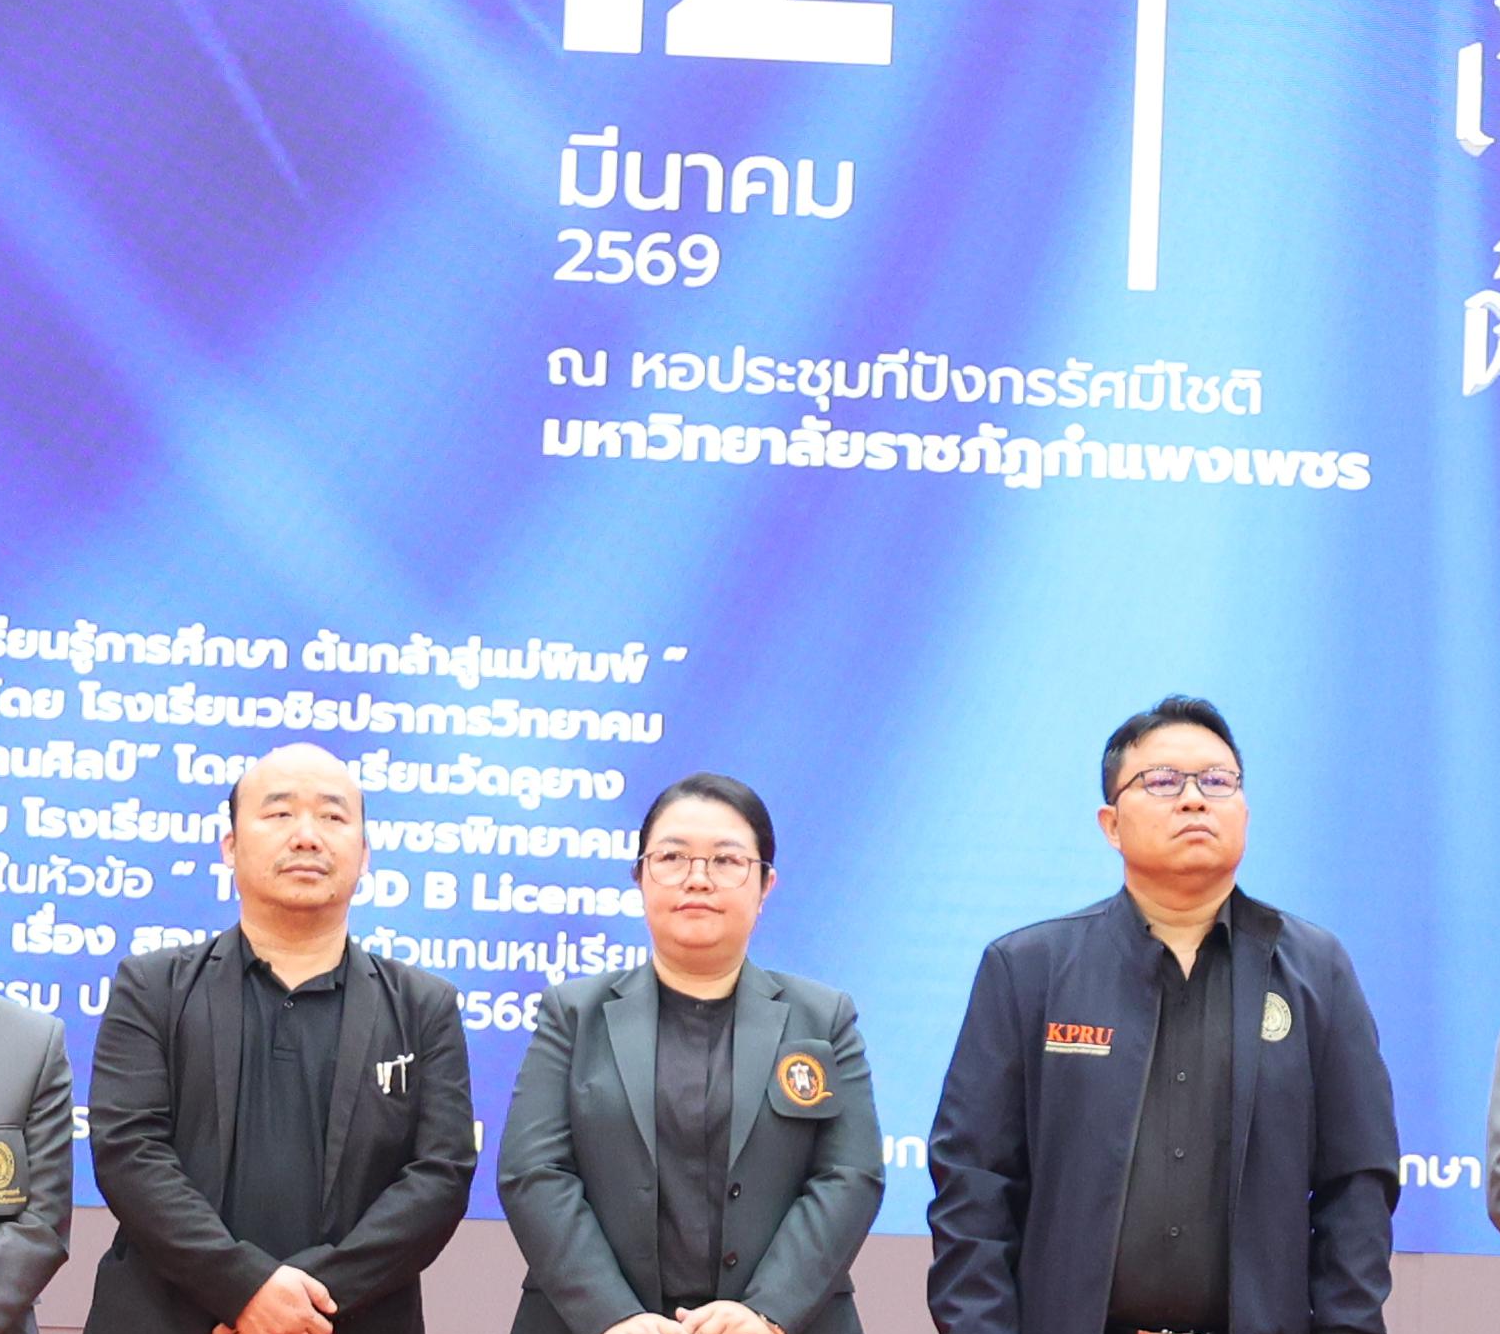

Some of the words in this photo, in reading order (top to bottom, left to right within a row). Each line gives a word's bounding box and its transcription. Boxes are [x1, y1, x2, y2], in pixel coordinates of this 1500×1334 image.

[557, 125, 855, 219] มีนาคม
[553, 228, 722, 288] 2569
[546, 346, 608, 388] ณ
[630, 344, 1263, 416] หอประชุมทีปังกรรัศมีโชติ
[301, 628, 649, 691] ต้นกล้าสู่แม่พิมพ์
[78, 679, 665, 744] โรงเรียนวชิรปราการวิทยาคม
[423, 870, 459, 910] B
[10, 902, 117, 957] เรื่อง
[1046, 1022, 1115, 1045] KPRU
